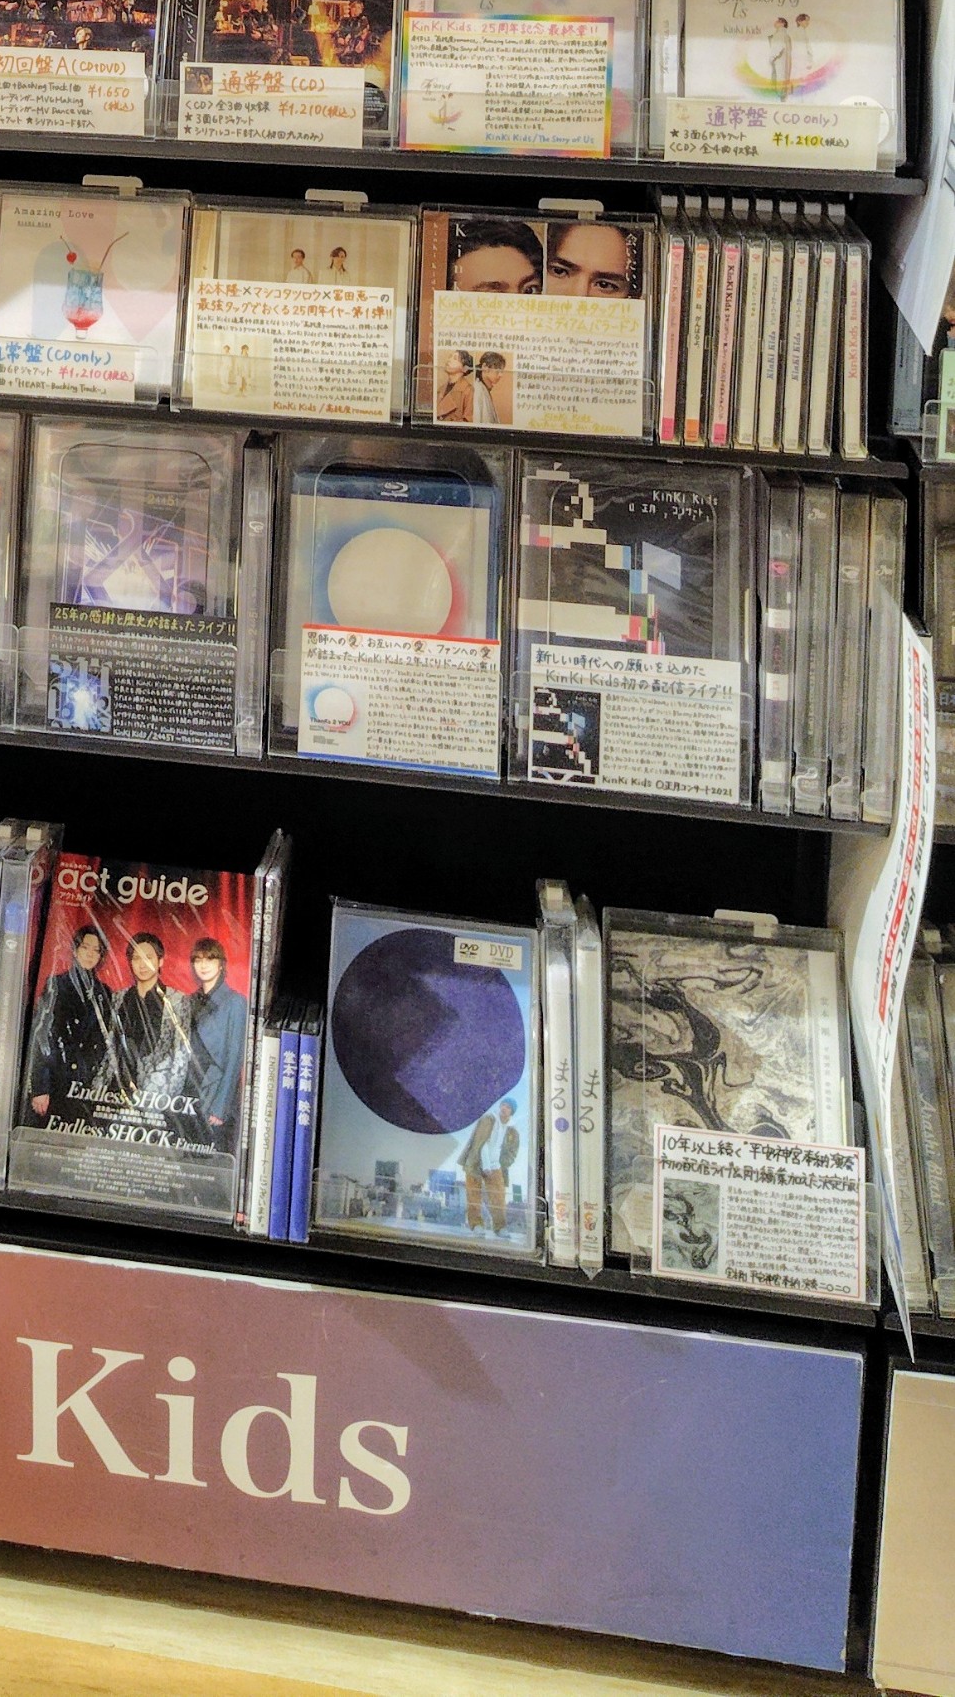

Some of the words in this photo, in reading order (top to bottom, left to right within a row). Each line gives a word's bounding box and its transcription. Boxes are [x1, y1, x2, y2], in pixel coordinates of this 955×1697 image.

[411, 21, 443, 33] KinKi
[14, 207, 62, 218] Amazing
[68, 209, 95, 220] Love
[727, 264, 736, 291] KinKi
[725, 292, 734, 311] Kids
[652, 489, 685, 504] KinKi
[54, 606, 236, 638] 25年の感謝と歴史が詰まったライブ!!
[535, 649, 706, 678] 新しい時代への願いを込めた
[546, 669, 585, 685] KinKi
[57, 866, 111, 895] act
[117, 875, 210, 906] guide
[459, 942, 480, 954] DVD
[489, 944, 514, 959] DVD
[281, 1050, 297, 1090] 堂本剛
[299, 1053, 313, 1091] 堂本剛
[65, 1079, 127, 1107] Endless
[129, 1087, 200, 1116] SHOCK
[297, 1100, 312, 1127] 映像
[45, 1114, 105, 1138] Endless
[106, 1122, 173, 1148] SHOCK
[15, 1336, 413, 1516] Kids
